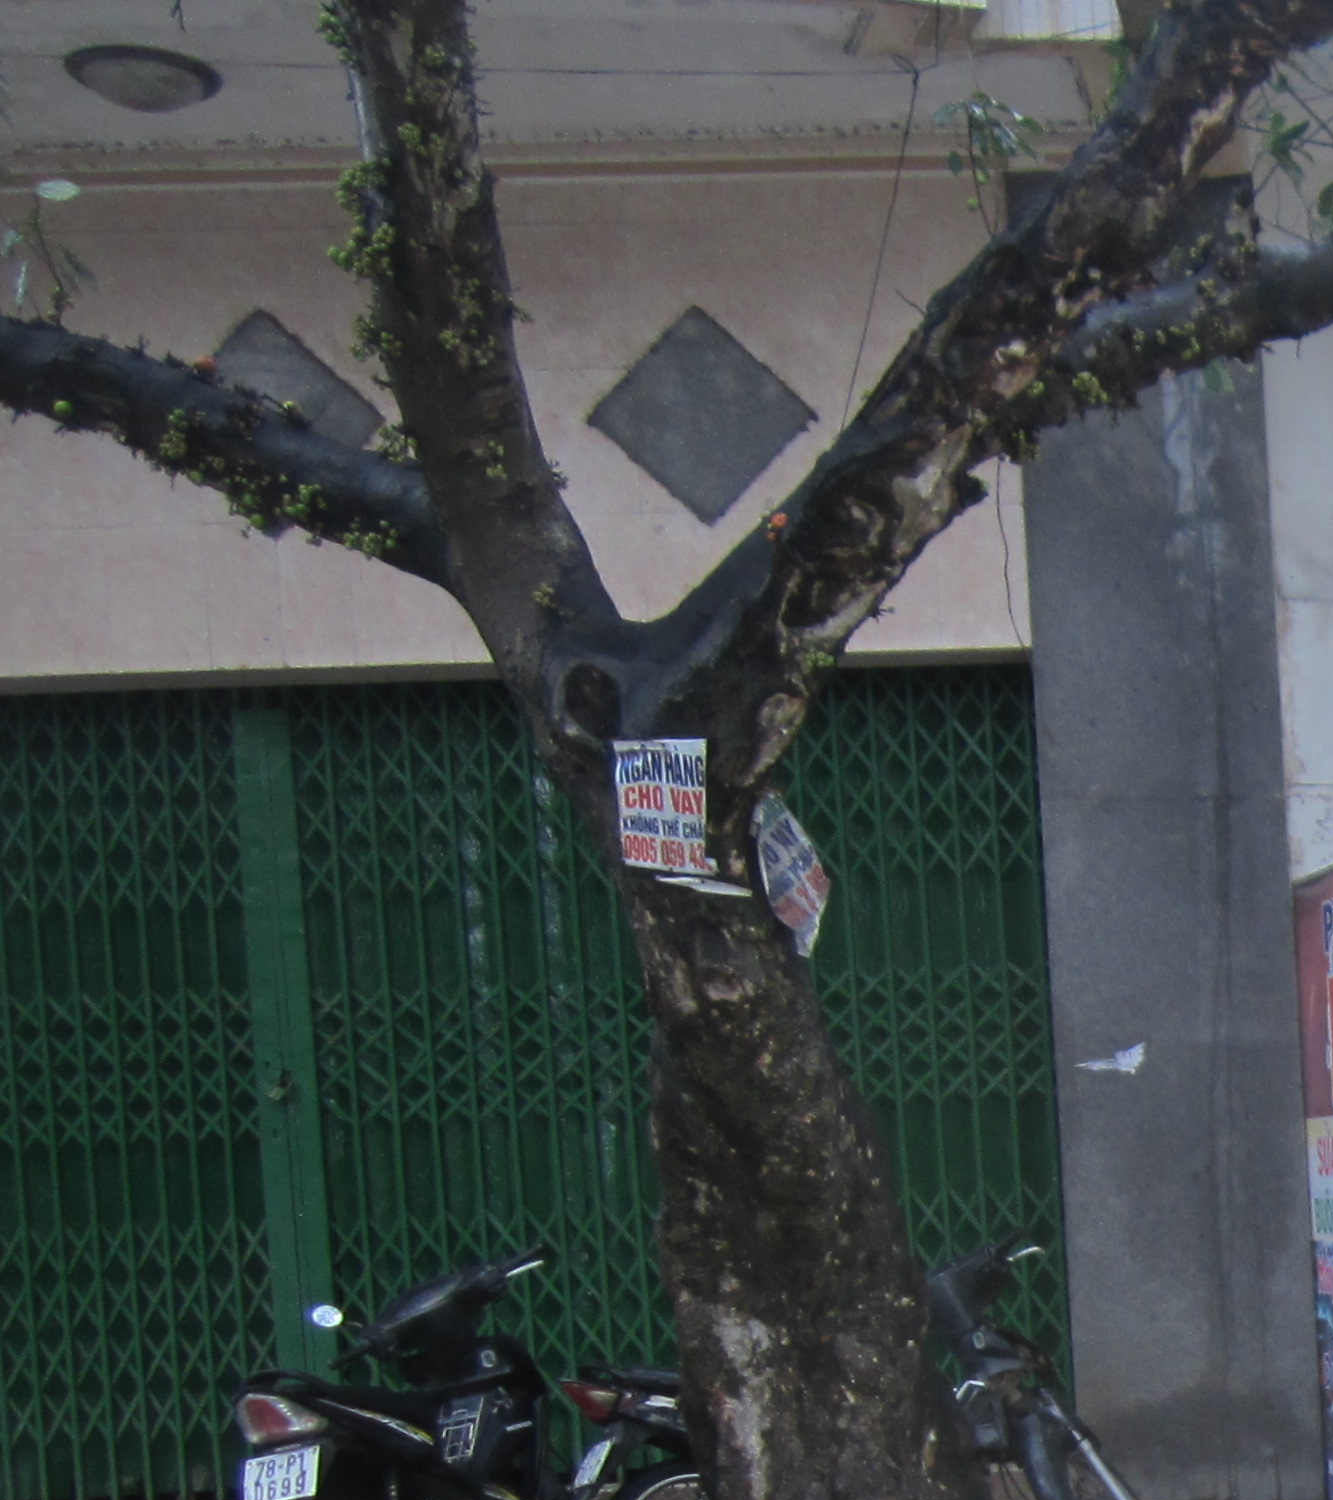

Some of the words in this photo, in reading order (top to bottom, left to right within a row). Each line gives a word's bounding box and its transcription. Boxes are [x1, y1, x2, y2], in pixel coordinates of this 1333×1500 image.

[618, 745, 664, 785] NGÂN
[664, 749, 705, 786] HÀNG
[623, 785, 664, 811] CHO
[670, 787, 704, 815] VAY
[623, 835, 657, 863] 0905
[254, 1452, 306, 1485] 78-P1
